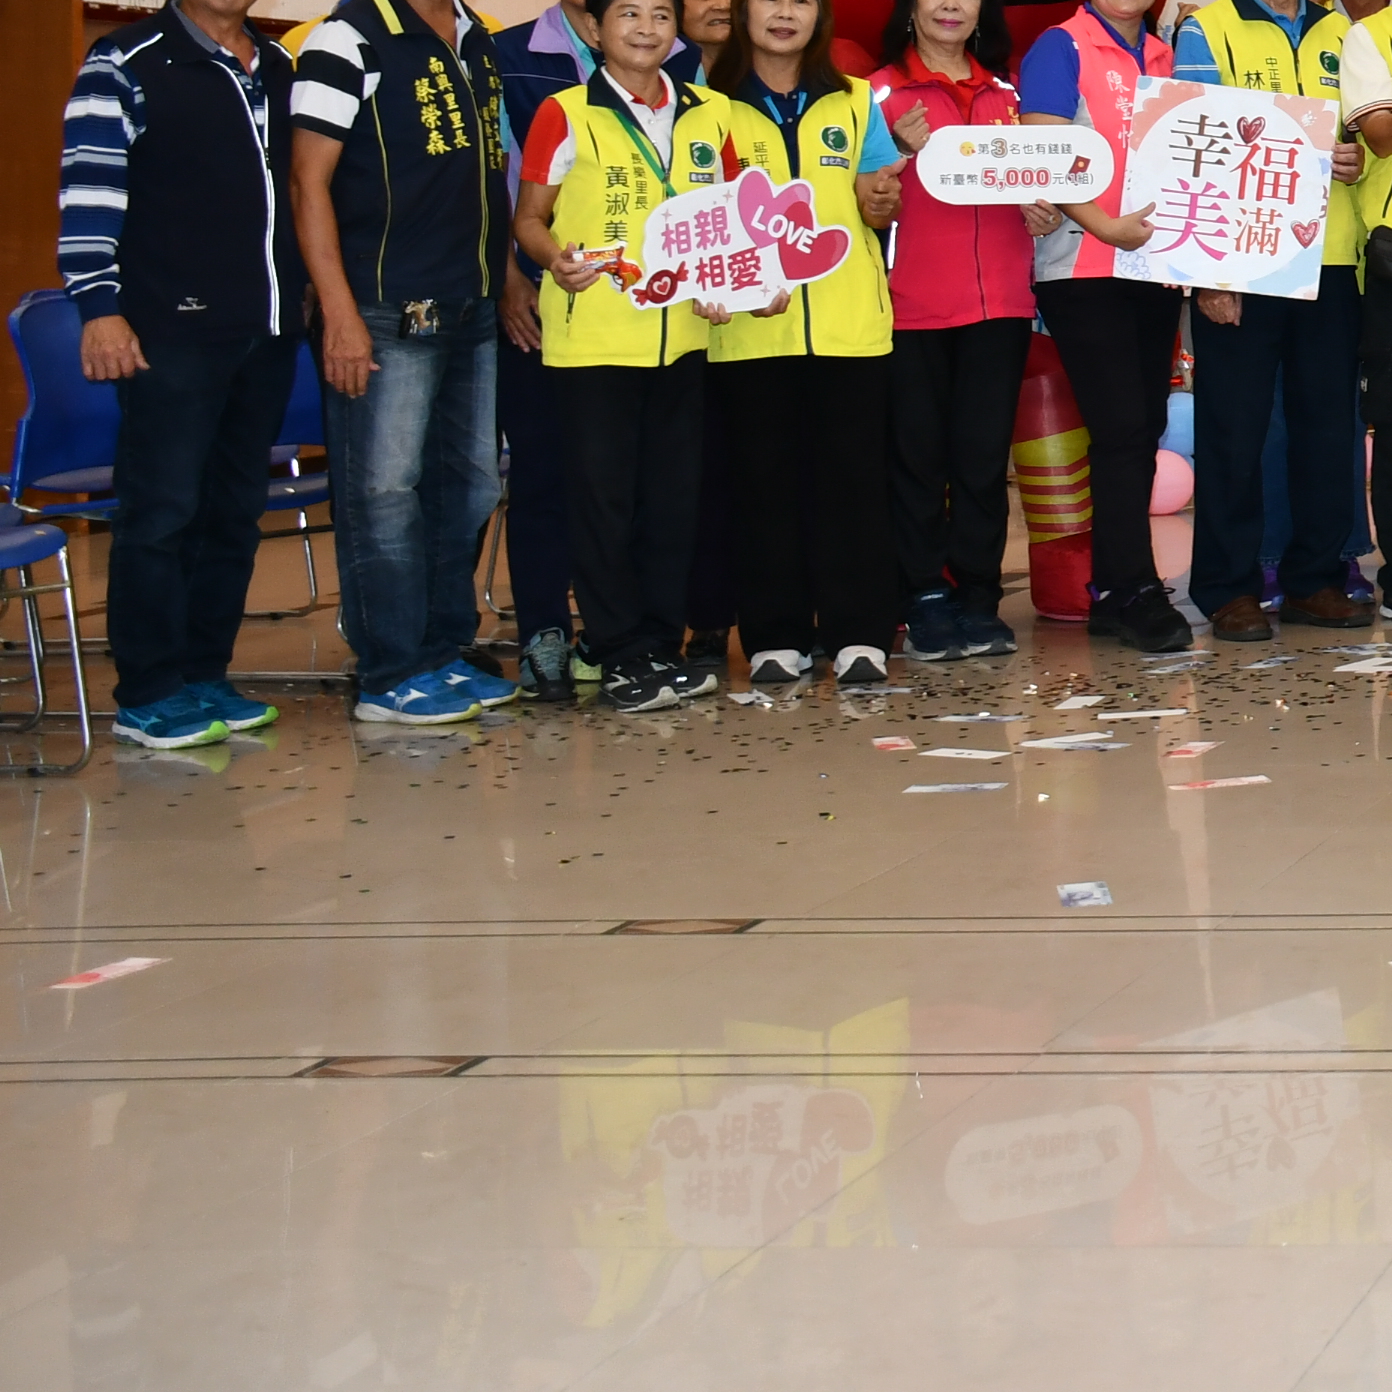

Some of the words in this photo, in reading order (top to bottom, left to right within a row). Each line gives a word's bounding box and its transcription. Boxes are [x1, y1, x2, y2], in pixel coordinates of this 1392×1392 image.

[414, 77, 453, 156] 蔡榮森
[429, 56, 472, 149] 南興里里長
[978, 138, 1073, 158] 第3名也有錢錢
[1169, 114, 1305, 205] 幸福
[603, 165, 631, 243] 黃淑美
[661, 206, 731, 258] 相親
[751, 205, 818, 254] LOVE
[1149, 178, 1284, 262] 美滿
[695, 246, 763, 292] 相愛
